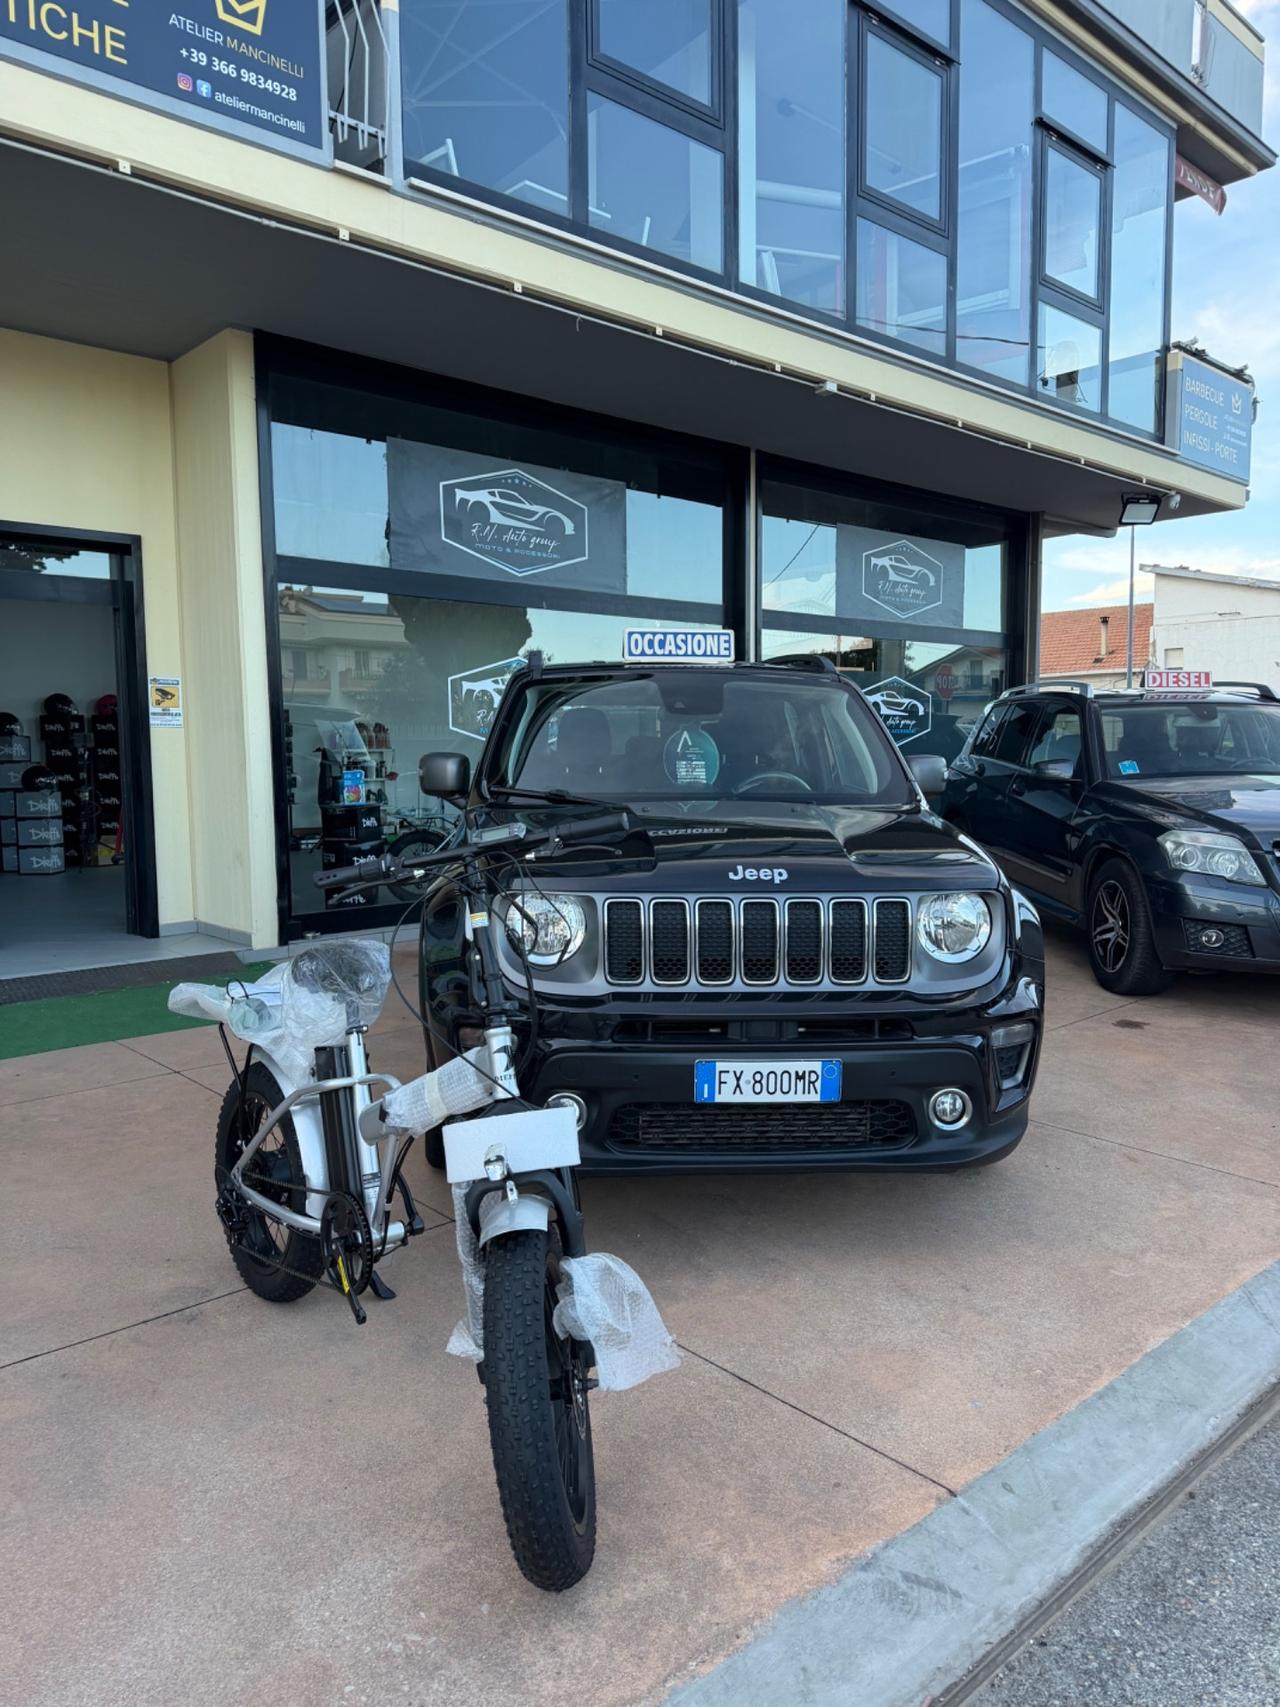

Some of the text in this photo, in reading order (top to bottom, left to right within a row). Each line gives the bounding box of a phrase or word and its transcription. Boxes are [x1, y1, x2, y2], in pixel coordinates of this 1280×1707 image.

[168, 13, 305, 78] ATELIER MANCINELLI
[180, 47, 298, 101] +39 366 9834928
[214, 91, 306, 133] ateliermancinelli
[1215, 441, 1238, 464] PORTE
[630, 633, 729, 655] OCCASIONE
[1149, 673, 1210, 687] DIESEL
[728, 865, 789, 884] Jeep
